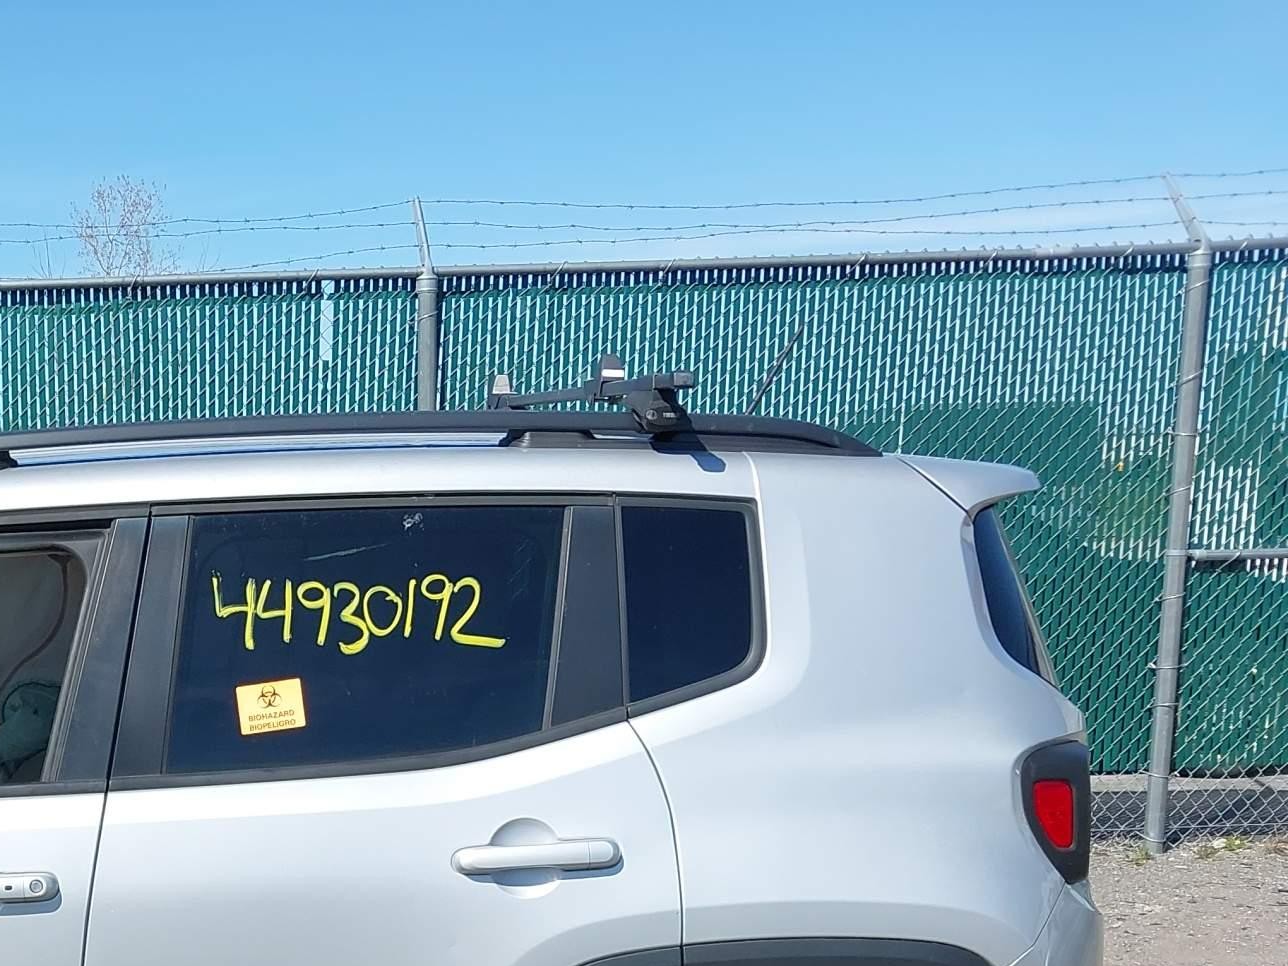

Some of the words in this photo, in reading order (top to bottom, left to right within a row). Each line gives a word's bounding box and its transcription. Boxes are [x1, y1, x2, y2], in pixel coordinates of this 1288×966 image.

[212, 573, 507, 656] 44930192
[248, 709, 295, 722] BIOHAZARD
[249, 718, 296, 732] BIOPELIGRO
